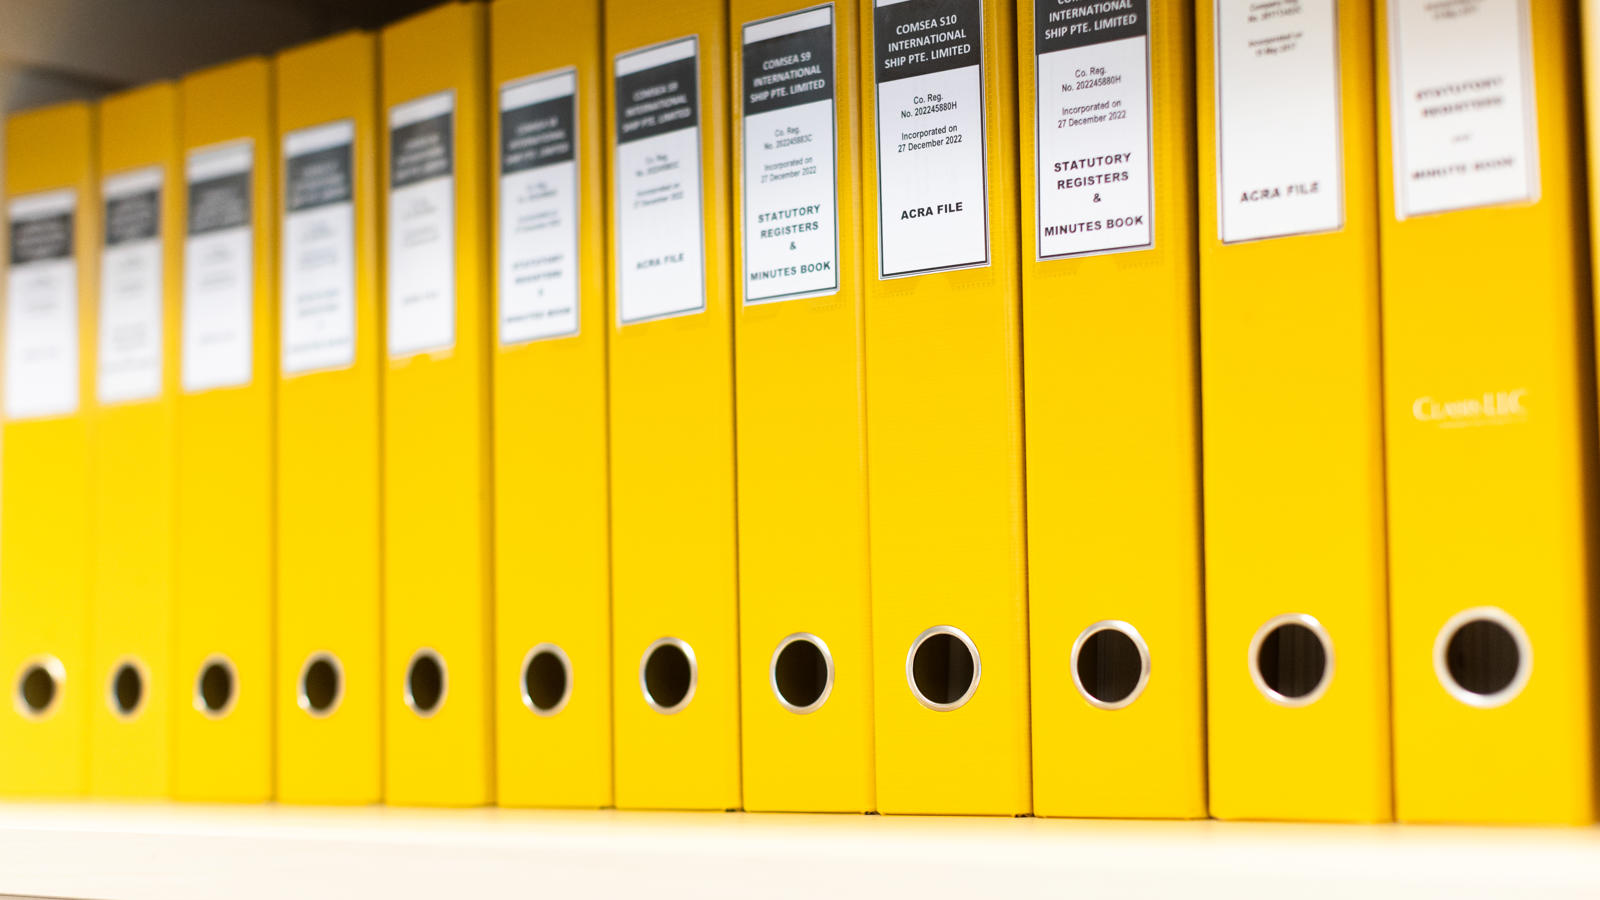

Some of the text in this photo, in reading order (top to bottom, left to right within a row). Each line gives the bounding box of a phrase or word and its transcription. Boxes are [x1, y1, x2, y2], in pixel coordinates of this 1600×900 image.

[1049, 0, 1132, 22] INTERNATIONAL
[896, 14, 957, 35] COMSEA S10
[1044, 14, 1137, 40] SHIP PTE. LIMITED
[888, 29, 966, 52] INTERNATIONAL
[763, 51, 812, 70] COMSEA S9
[884, 44, 970, 68] SHIP PTE. LIMITED
[753, 64, 821, 87] INTERNATIONAL
[1075, 66, 1106, 78] Co. Reg.
[750, 79, 825, 103] SHIP PTE. LIMITED
[1062, 75, 1122, 92] No. 202245880H
[914, 94, 944, 104] Co. Reg.
[1062, 100, 1121, 116] Incorporated on
[901, 102, 957, 118] No. 202245880H
[1058, 110, 1126, 128] 27 December 2022
[902, 124, 958, 140] Incorporated on
[898, 134, 962, 152] 27 December 2022
[1054, 152, 1131, 172] STATUTORY
[1058, 171, 1129, 190] REGISTERS
[1093, 193, 1102, 203] &
[1240, 182, 1318, 202] ACRA FILE
[758, 204, 820, 223] STATUTORY
[901, 202, 963, 220] ACRA FILE
[760, 221, 819, 239] REGISTERS
[1044, 216, 1143, 236] MINUTES BOOK
[789, 241, 796, 250] &
[750, 261, 831, 280] MINUTES BOOK
